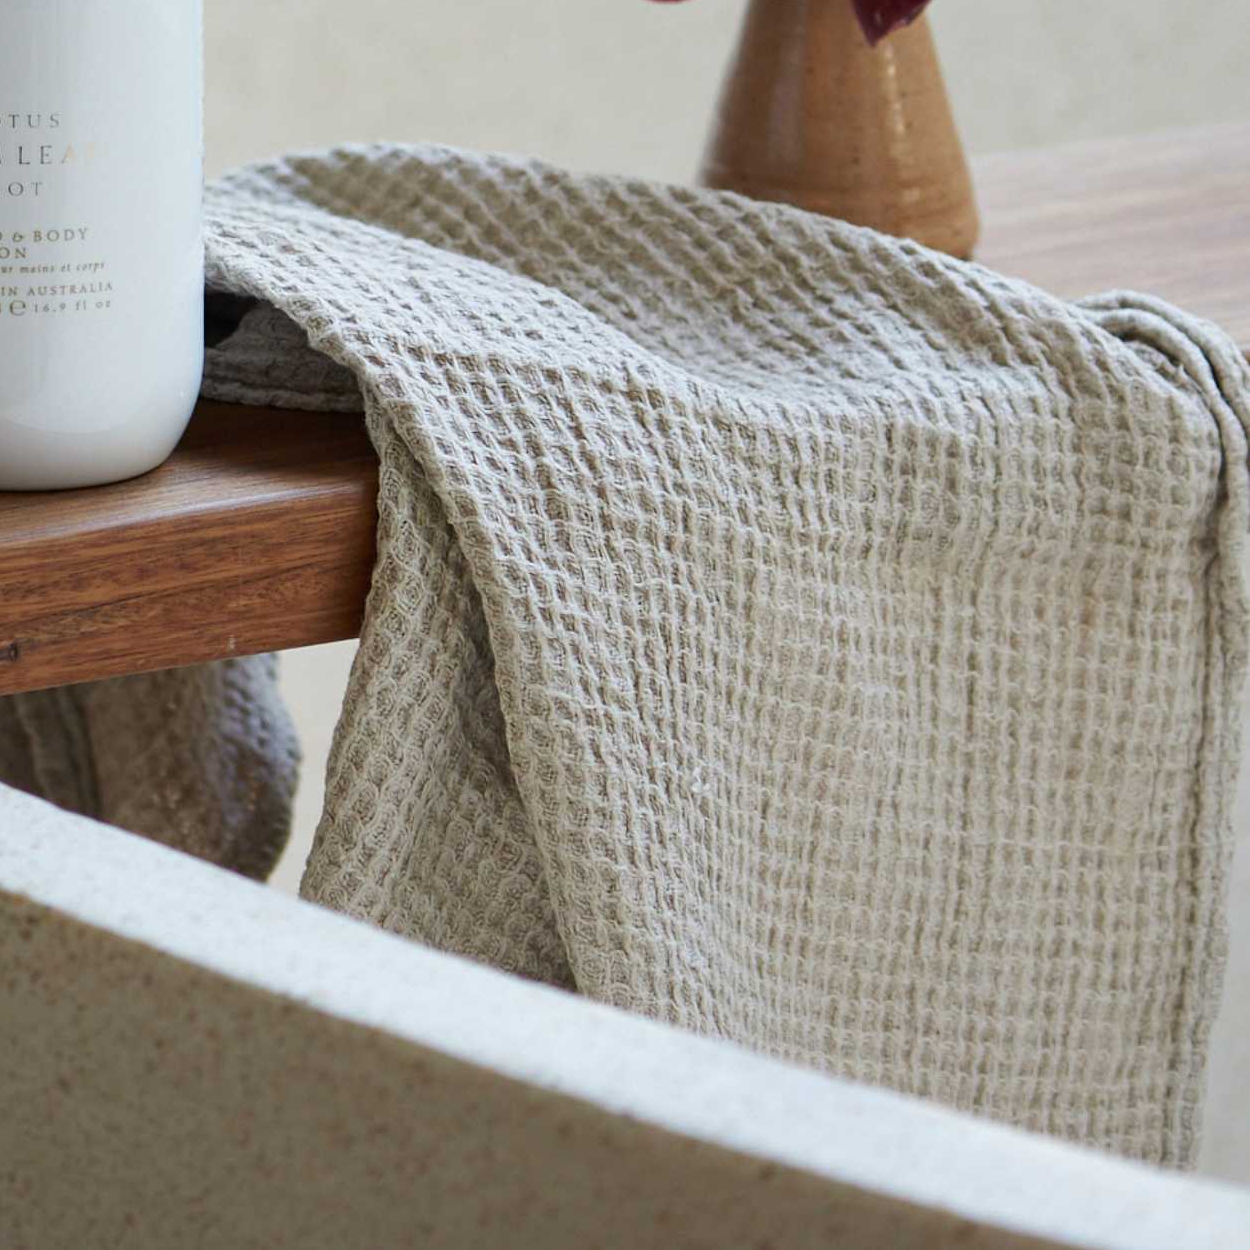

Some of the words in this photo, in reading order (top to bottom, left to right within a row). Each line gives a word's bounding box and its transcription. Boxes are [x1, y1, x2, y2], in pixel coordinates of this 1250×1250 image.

[12, 231, 26, 243] &
[33, 227, 88, 243] BODY
[19, 264, 55, 274] mains
[61, 262, 71, 273] et
[75, 261, 106, 274] corps
[0, 286, 18, 296] IN
[26, 281, 113, 297] AUSTRALIA
[95, 299, 112, 309] oz
